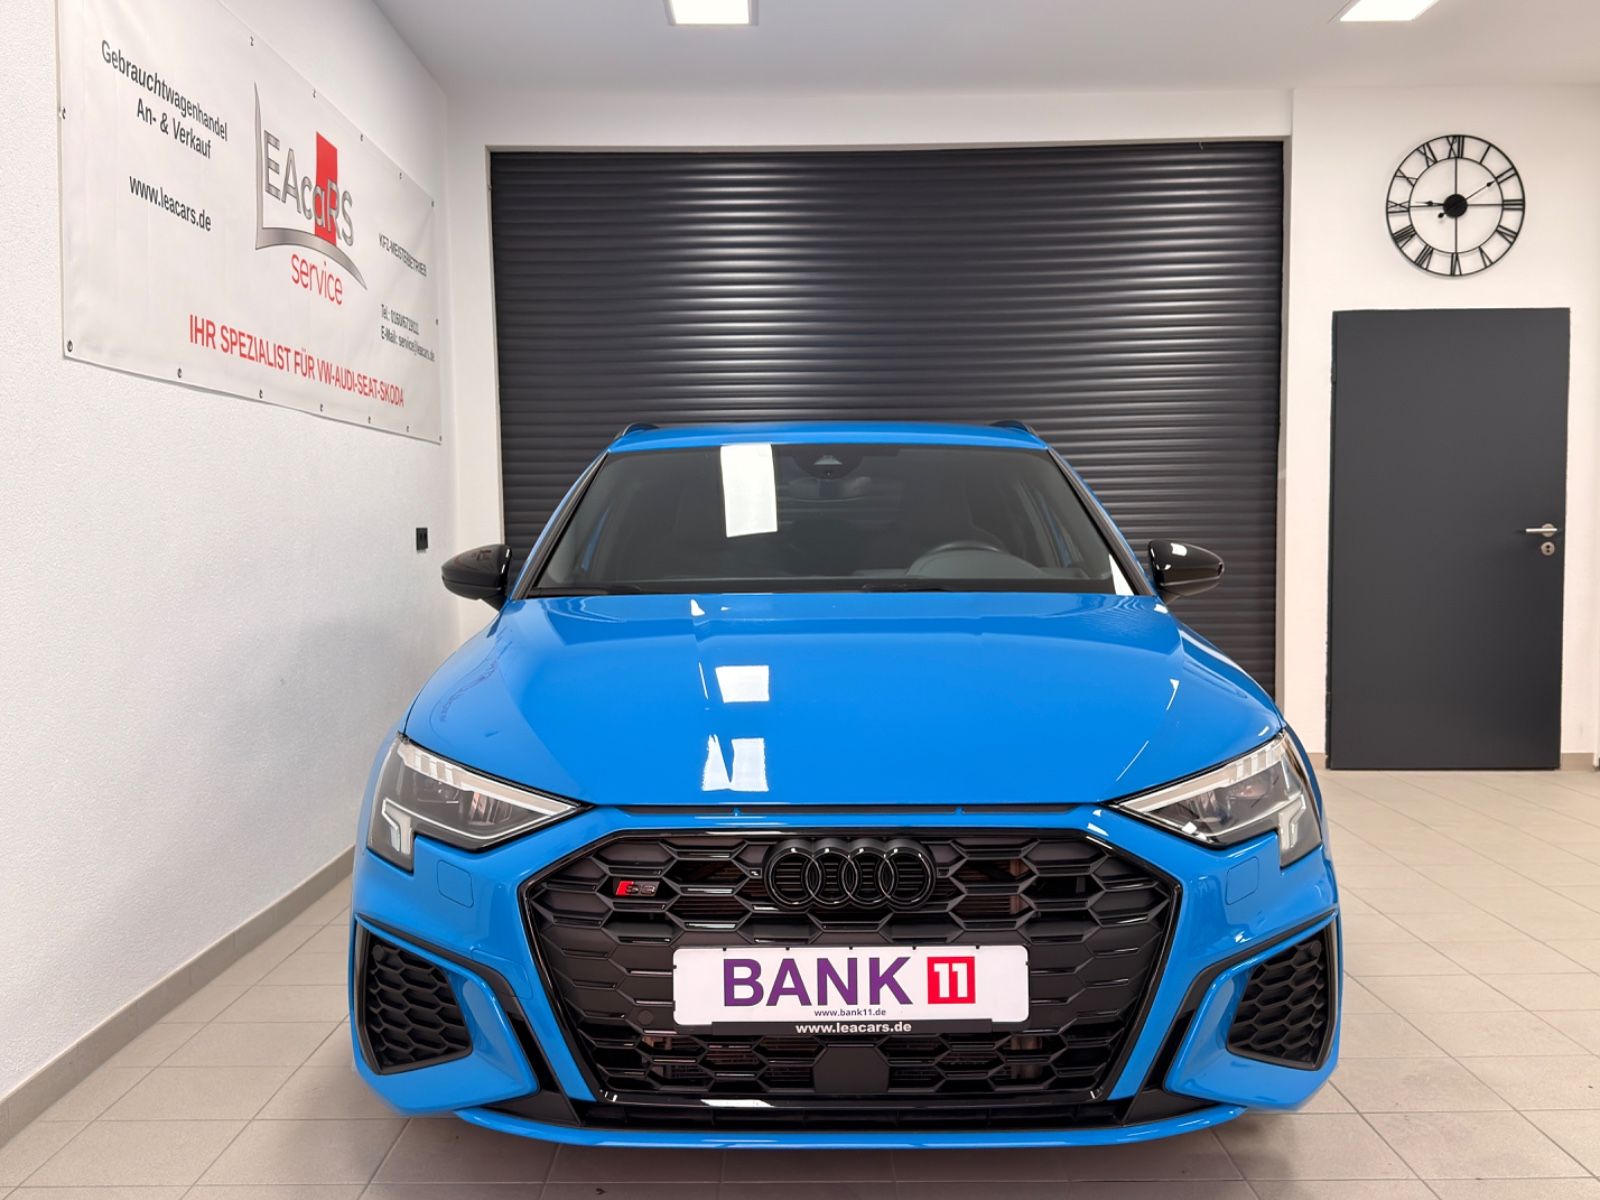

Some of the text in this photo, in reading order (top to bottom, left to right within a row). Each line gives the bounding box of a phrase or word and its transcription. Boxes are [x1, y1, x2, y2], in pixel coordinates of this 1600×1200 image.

[101, 39, 228, 141] Gebrauchtwagenhandel
[136, 98, 211, 159] An- & Verkauf
[129, 176, 212, 232] www.leacars.de
[291, 254, 343, 306] service
[189, 314, 405, 408] IHR SPEZIALIST FÜR VW-AUDI-SEAT-SKODA
[723, 956, 971, 1007] BANK 11
[795, 1021, 912, 1035] www.leacars.de
[814, 1007, 887, 1018] www.bank11.de
